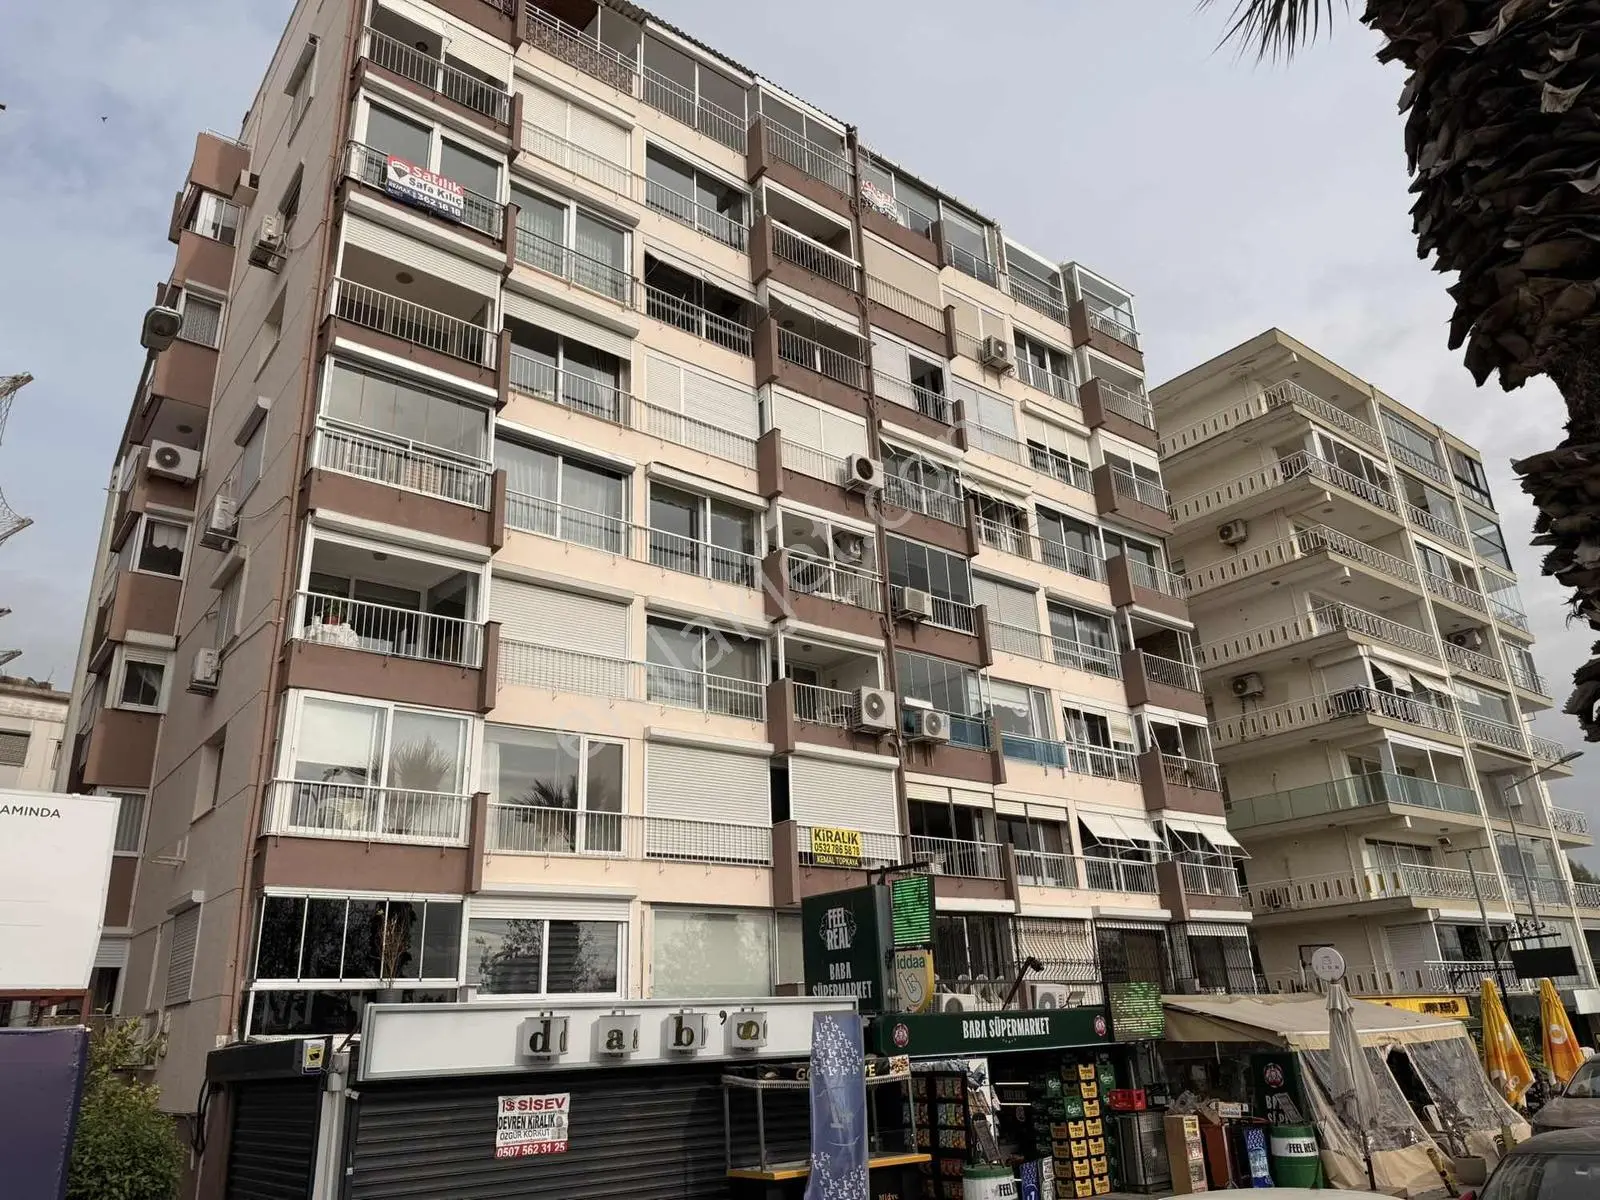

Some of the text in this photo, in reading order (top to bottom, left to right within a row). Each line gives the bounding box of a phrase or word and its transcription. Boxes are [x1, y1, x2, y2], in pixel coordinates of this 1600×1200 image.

[413, 166, 464, 195] Satılık
[408, 177, 434, 194] Safa
[437, 188, 462, 207] Kılıç
[0, 804, 61, 818] AMINDA
[827, 907, 847, 929] FEEL
[826, 926, 851, 951] REAL
[829, 961, 852, 980] BABA
[896, 954, 926, 970] iddaa
[812, 980, 873, 999] SÜPERMARKET
[962, 1016, 1050, 1040] BABA SÜPERMARKET
[517, 1097, 566, 1111] SİSEV
[498, 1115, 527, 1130] DEVREN
[497, 1142, 565, 1158] 0507 562 31 25
[1288, 1143, 1304, 1154] FEEL
